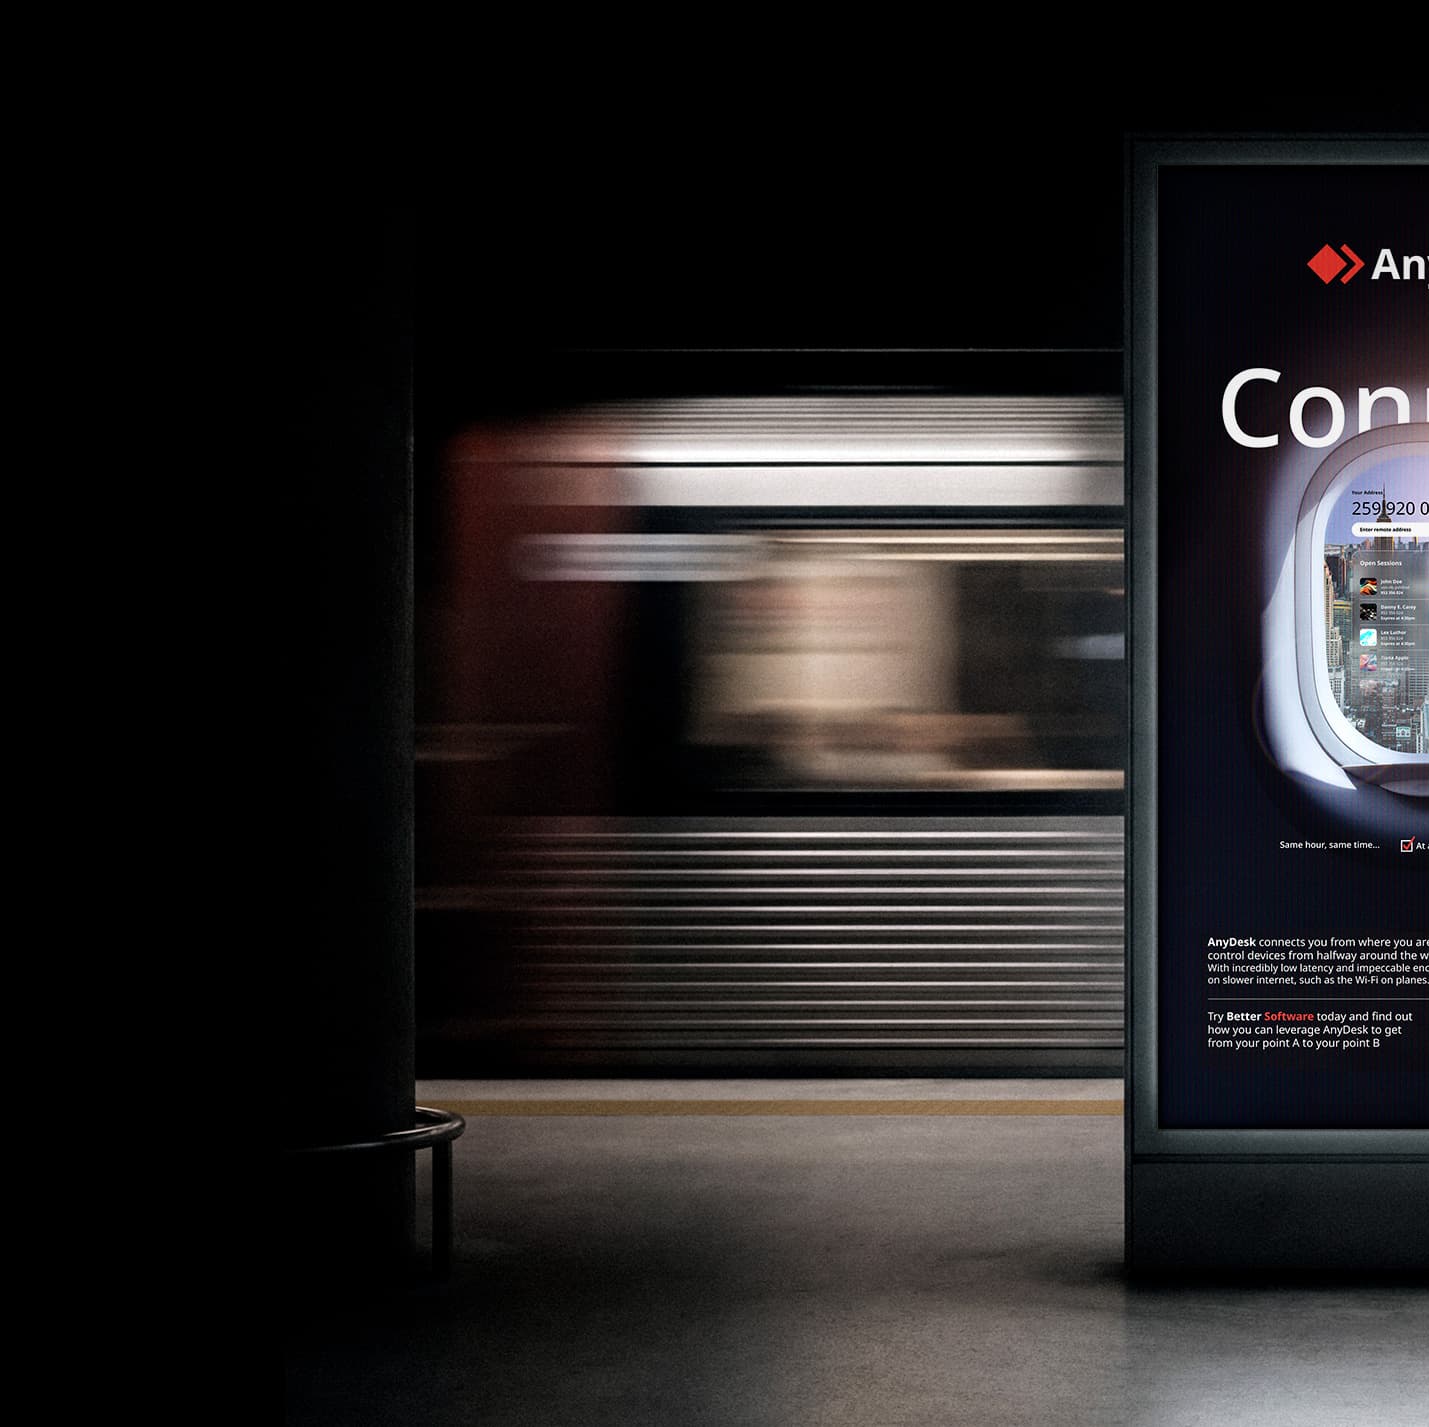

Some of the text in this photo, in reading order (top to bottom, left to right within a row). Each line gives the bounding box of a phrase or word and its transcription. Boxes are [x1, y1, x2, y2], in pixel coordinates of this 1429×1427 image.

[1352, 501, 1381, 516] 259
[1386, 501, 1415, 516] 920
[1359, 559, 1402, 567] Open Sessions
[1280, 840, 1379, 850] Same hour, same time...
[1415, 842, 1426, 850] At
[1207, 937, 1257, 950] AnyDesk
[1258, 937, 1306, 947] connects
[1307, 939, 1328, 950] you
[1330, 937, 1356, 947] from
[1357, 937, 1392, 947] where
[1393, 939, 1413, 950] you
[1207, 950, 1245, 961] control
[1247, 950, 1286, 961] devices
[1288, 950, 1314, 961] from
[1316, 950, 1358, 963] halfway
[1359, 950, 1398, 961] around
[1399, 950, 1418, 961] the
[1207, 963, 1230, 973] With
[1232, 963, 1279, 975] incredibly
[1280, 963, 1298, 973] low
[1299, 963, 1334, 975] latency
[1335, 963, 1355, 973] and
[1356, 963, 1411, 975] impeccable
[1207, 975, 1429, 987] on slower internet, such as the Wi-Fi on planes.
[1207, 1011, 1413, 1024] Try Better Software today and find out
[1207, 1024, 1403, 1038] how you can leverage AnyDesk to get
[1207, 1038, 1381, 1051] from your point A to your point B
